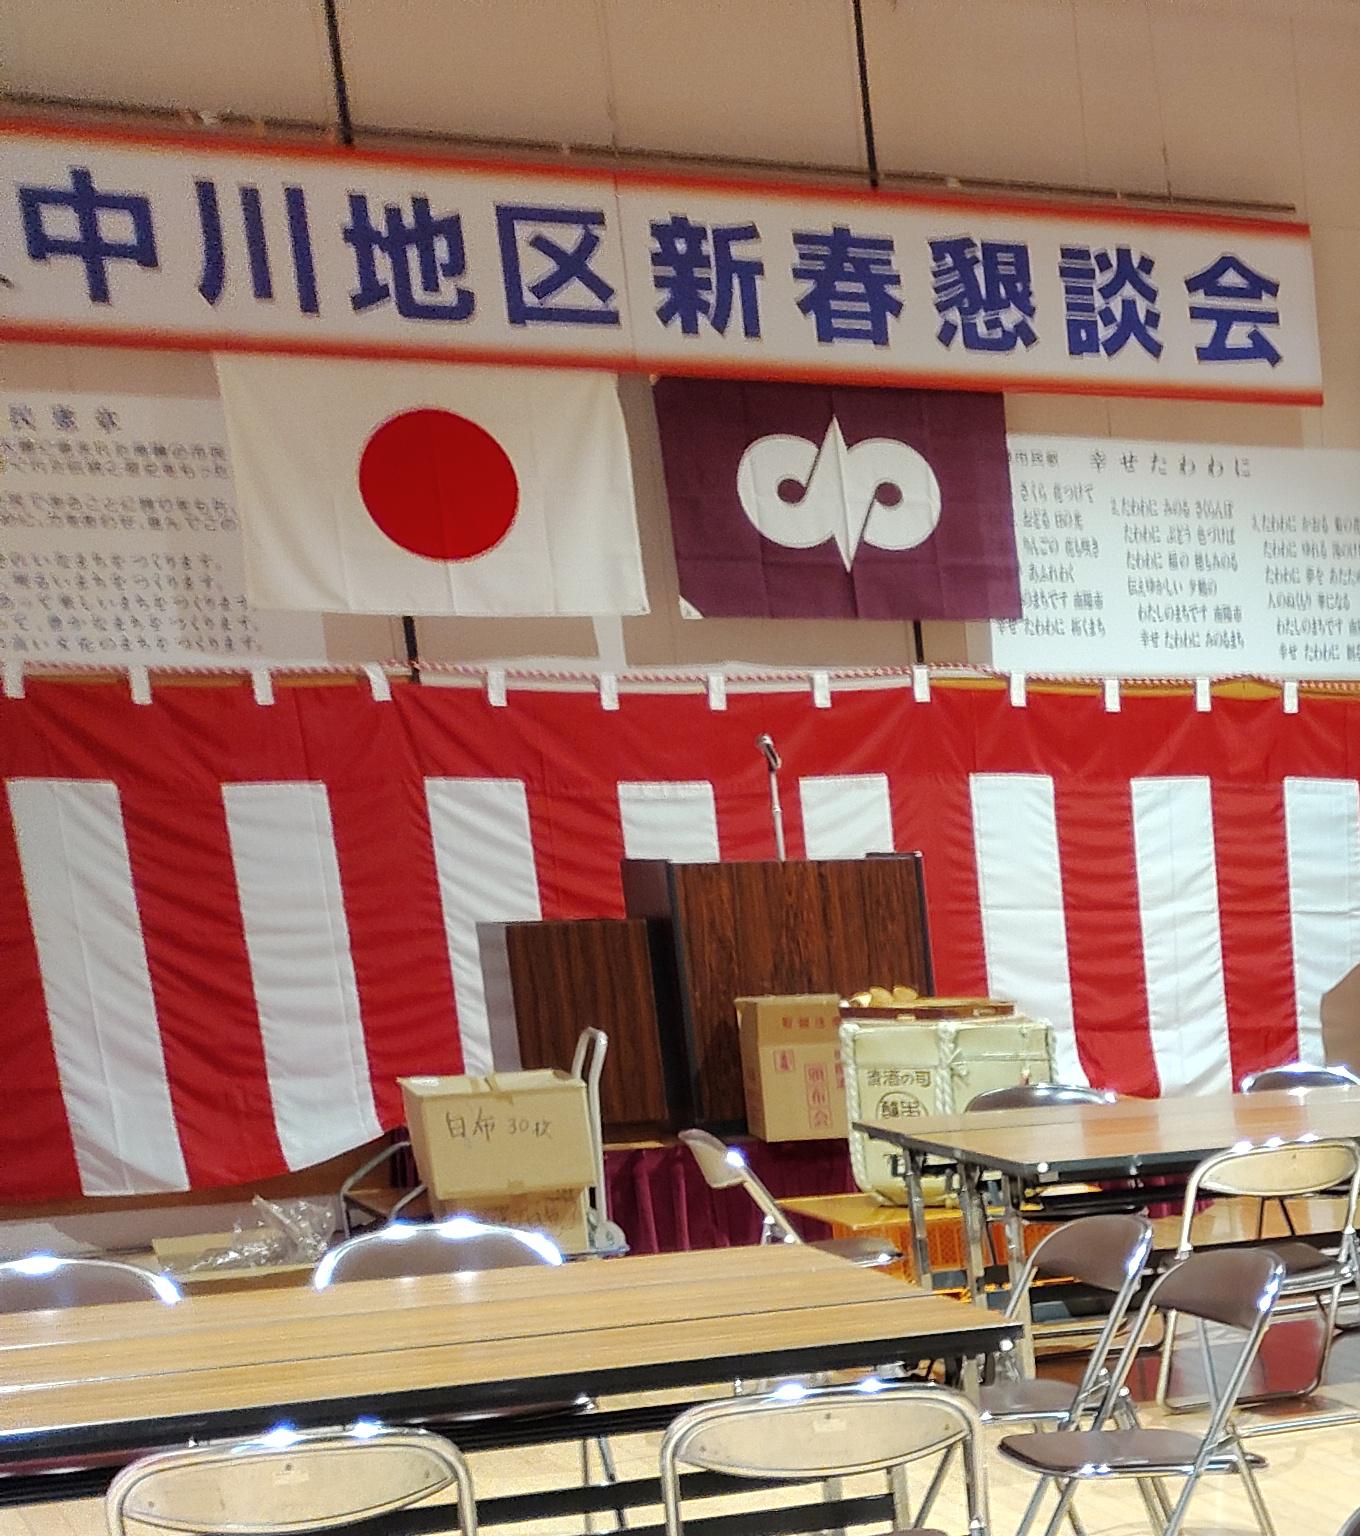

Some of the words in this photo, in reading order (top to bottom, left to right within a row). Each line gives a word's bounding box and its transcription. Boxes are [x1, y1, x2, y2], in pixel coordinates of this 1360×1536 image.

[0, 165, 1284, 368] 中川地区新春懇談会
